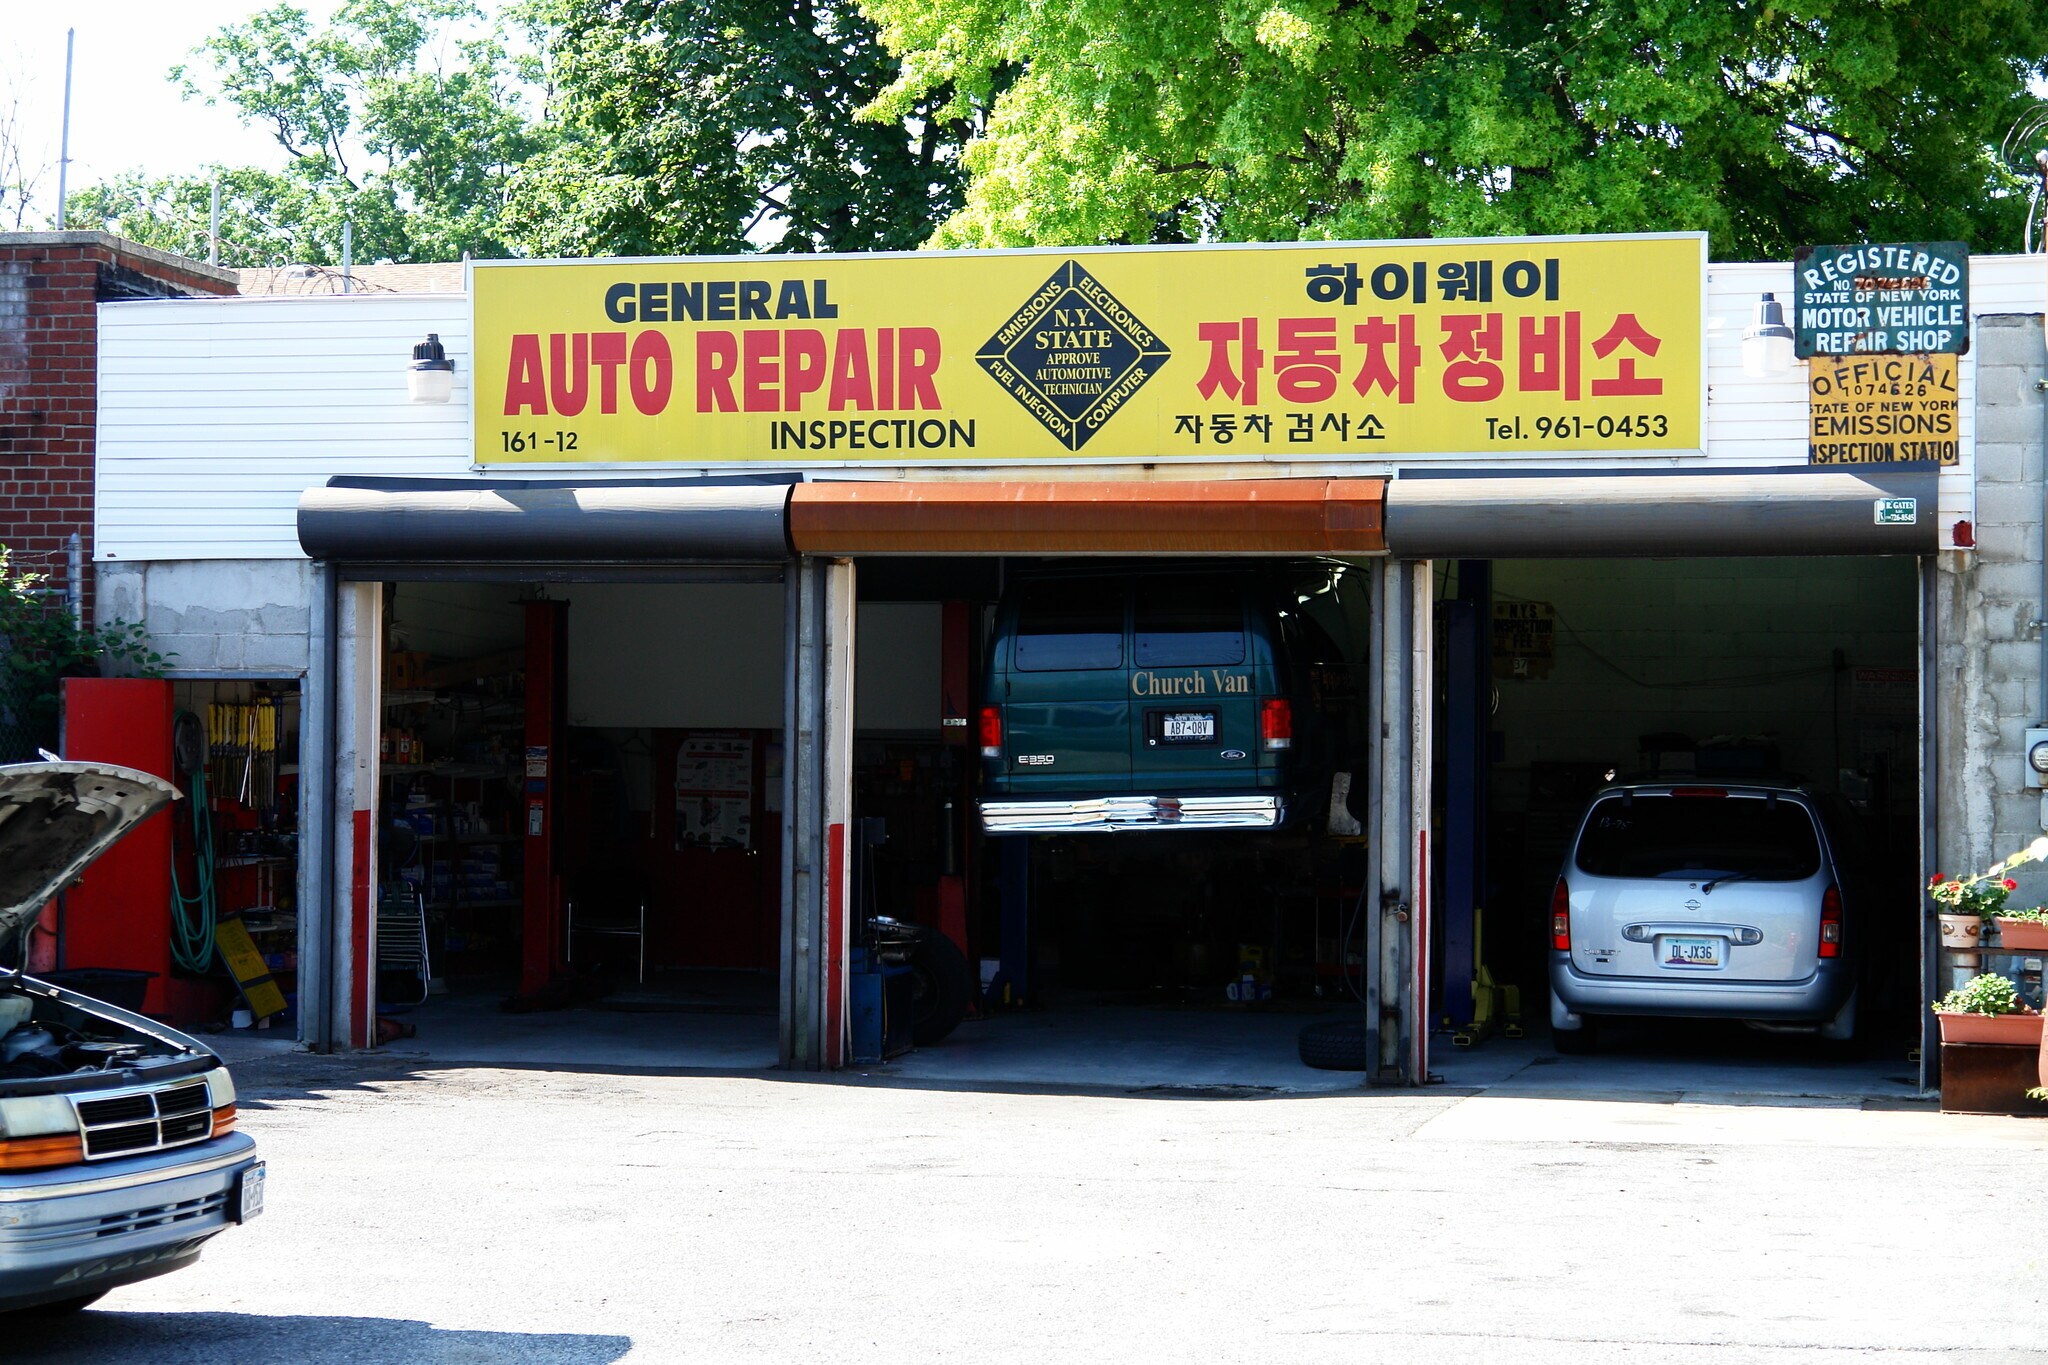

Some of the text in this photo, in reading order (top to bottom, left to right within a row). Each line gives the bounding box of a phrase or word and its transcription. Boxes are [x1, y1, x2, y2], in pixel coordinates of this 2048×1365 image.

[1803, 247, 1960, 290] REGISTERED
[1305, 258, 1560, 306] 하이웨이
[1833, 280, 1852, 291] NO.
[605, 279, 838, 323] GENERAL
[1804, 289, 1960, 304] STATE OF NEW YORK
[997, 281, 1062, 346] EMISSIONS
[1054, 308, 1094, 327] N.Y.
[1078, 276, 1154, 348] ELECTRONICS
[1802, 305, 1963, 329] MOTOR VEHICLE
[1035, 330, 1113, 350] STATE
[1816, 330, 1952, 352] REPAIR SHOP
[1046, 352, 1100, 365] APPROVE
[1195, 311, 1663, 406] 자동차정비소
[503, 326, 942, 416] AUTO REPAIR
[1035, 367, 1111, 381] AUTOMOTIVE
[1812, 361, 1956, 396] OFFICIAL
[989, 360, 1070, 438] FUEL INJECTION
[1044, 383, 1102, 395] TECHNICIAN
[1086, 367, 1148, 429] COMPUTER
[1855, 402, 1875, 412] OF
[1881, 401, 1913, 412] NEW
[1919, 400, 1959, 411] YORK
[771, 419, 975, 450] INSPECTION
[1174, 412, 1385, 444] 자동차 검사소
[1486, 415, 1669, 441] Tel. 961-0453
[1814, 413, 1952, 436] EMISSIONS
[502, 431, 578, 453] 161-12
[1809, 442, 1894, 463] NSPECTION
[1494, 619, 1552, 633] INSPECTION
[1513, 634, 1532, 648] FEE
[1132, 669, 1249, 696] Church Van
[1672, 945, 1712, 959] DL-JX36
